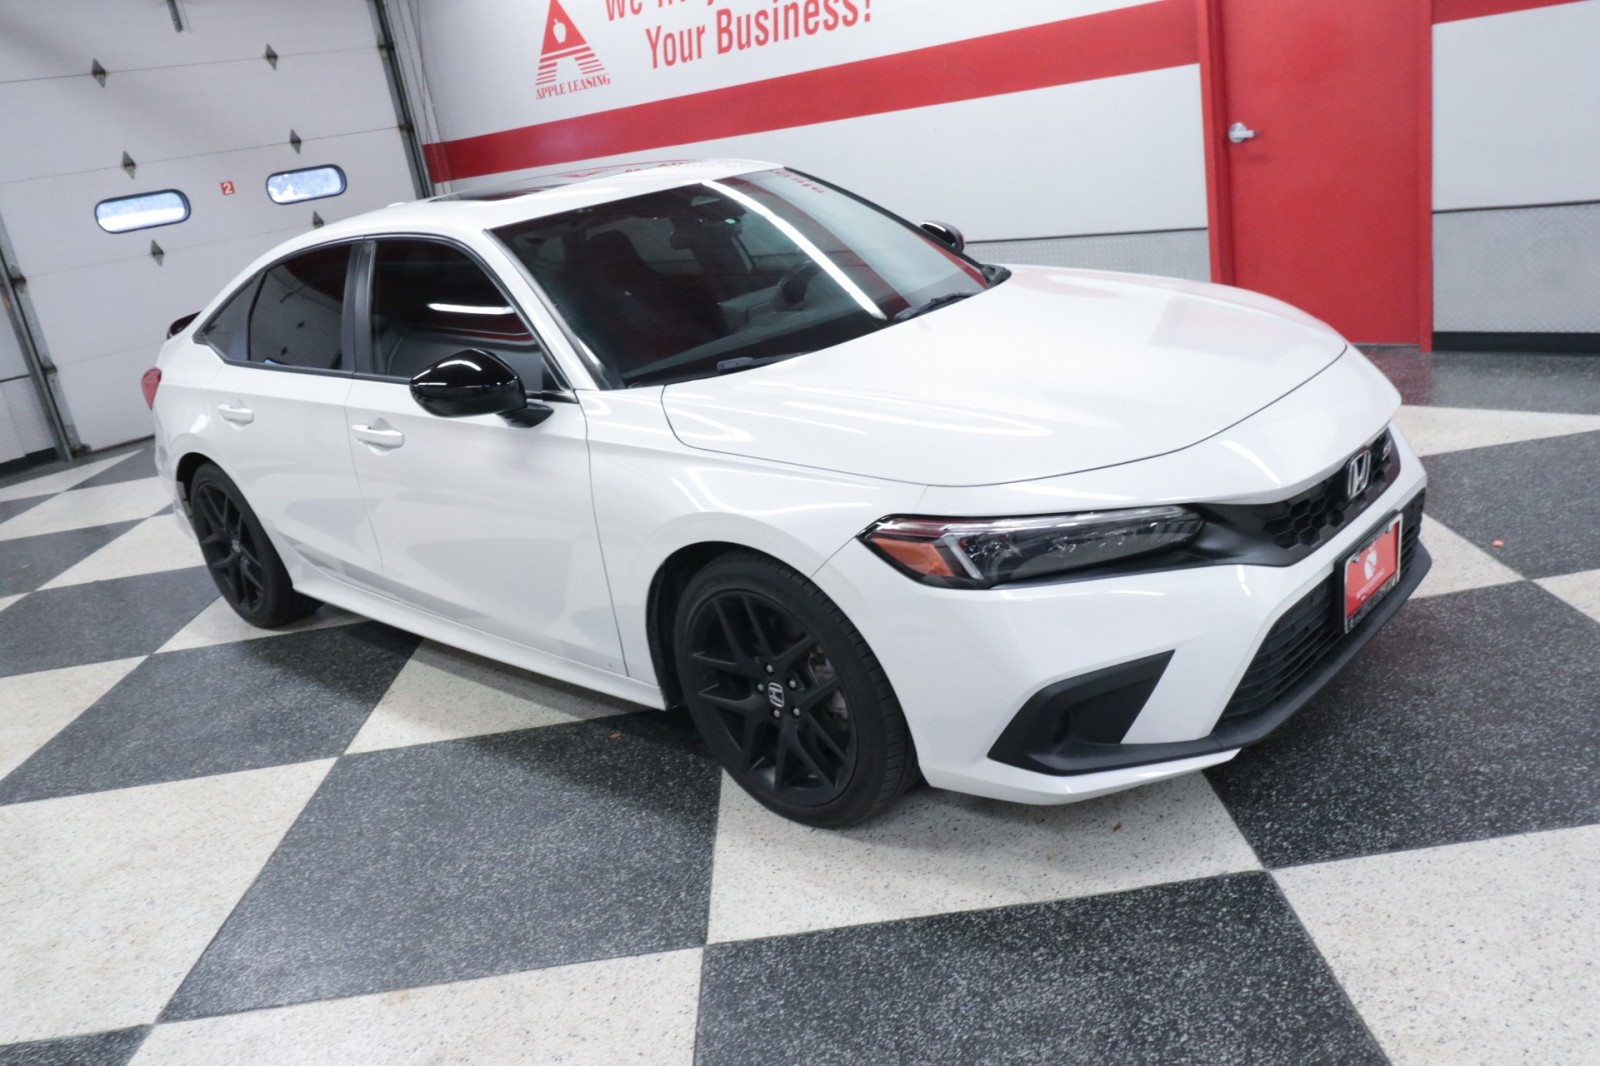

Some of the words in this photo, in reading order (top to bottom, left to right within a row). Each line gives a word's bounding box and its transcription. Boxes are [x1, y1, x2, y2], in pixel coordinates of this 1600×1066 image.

[645, 24, 706, 69] Your
[536, 83, 567, 100] APPLE
[567, 72, 611, 93] LEASING
